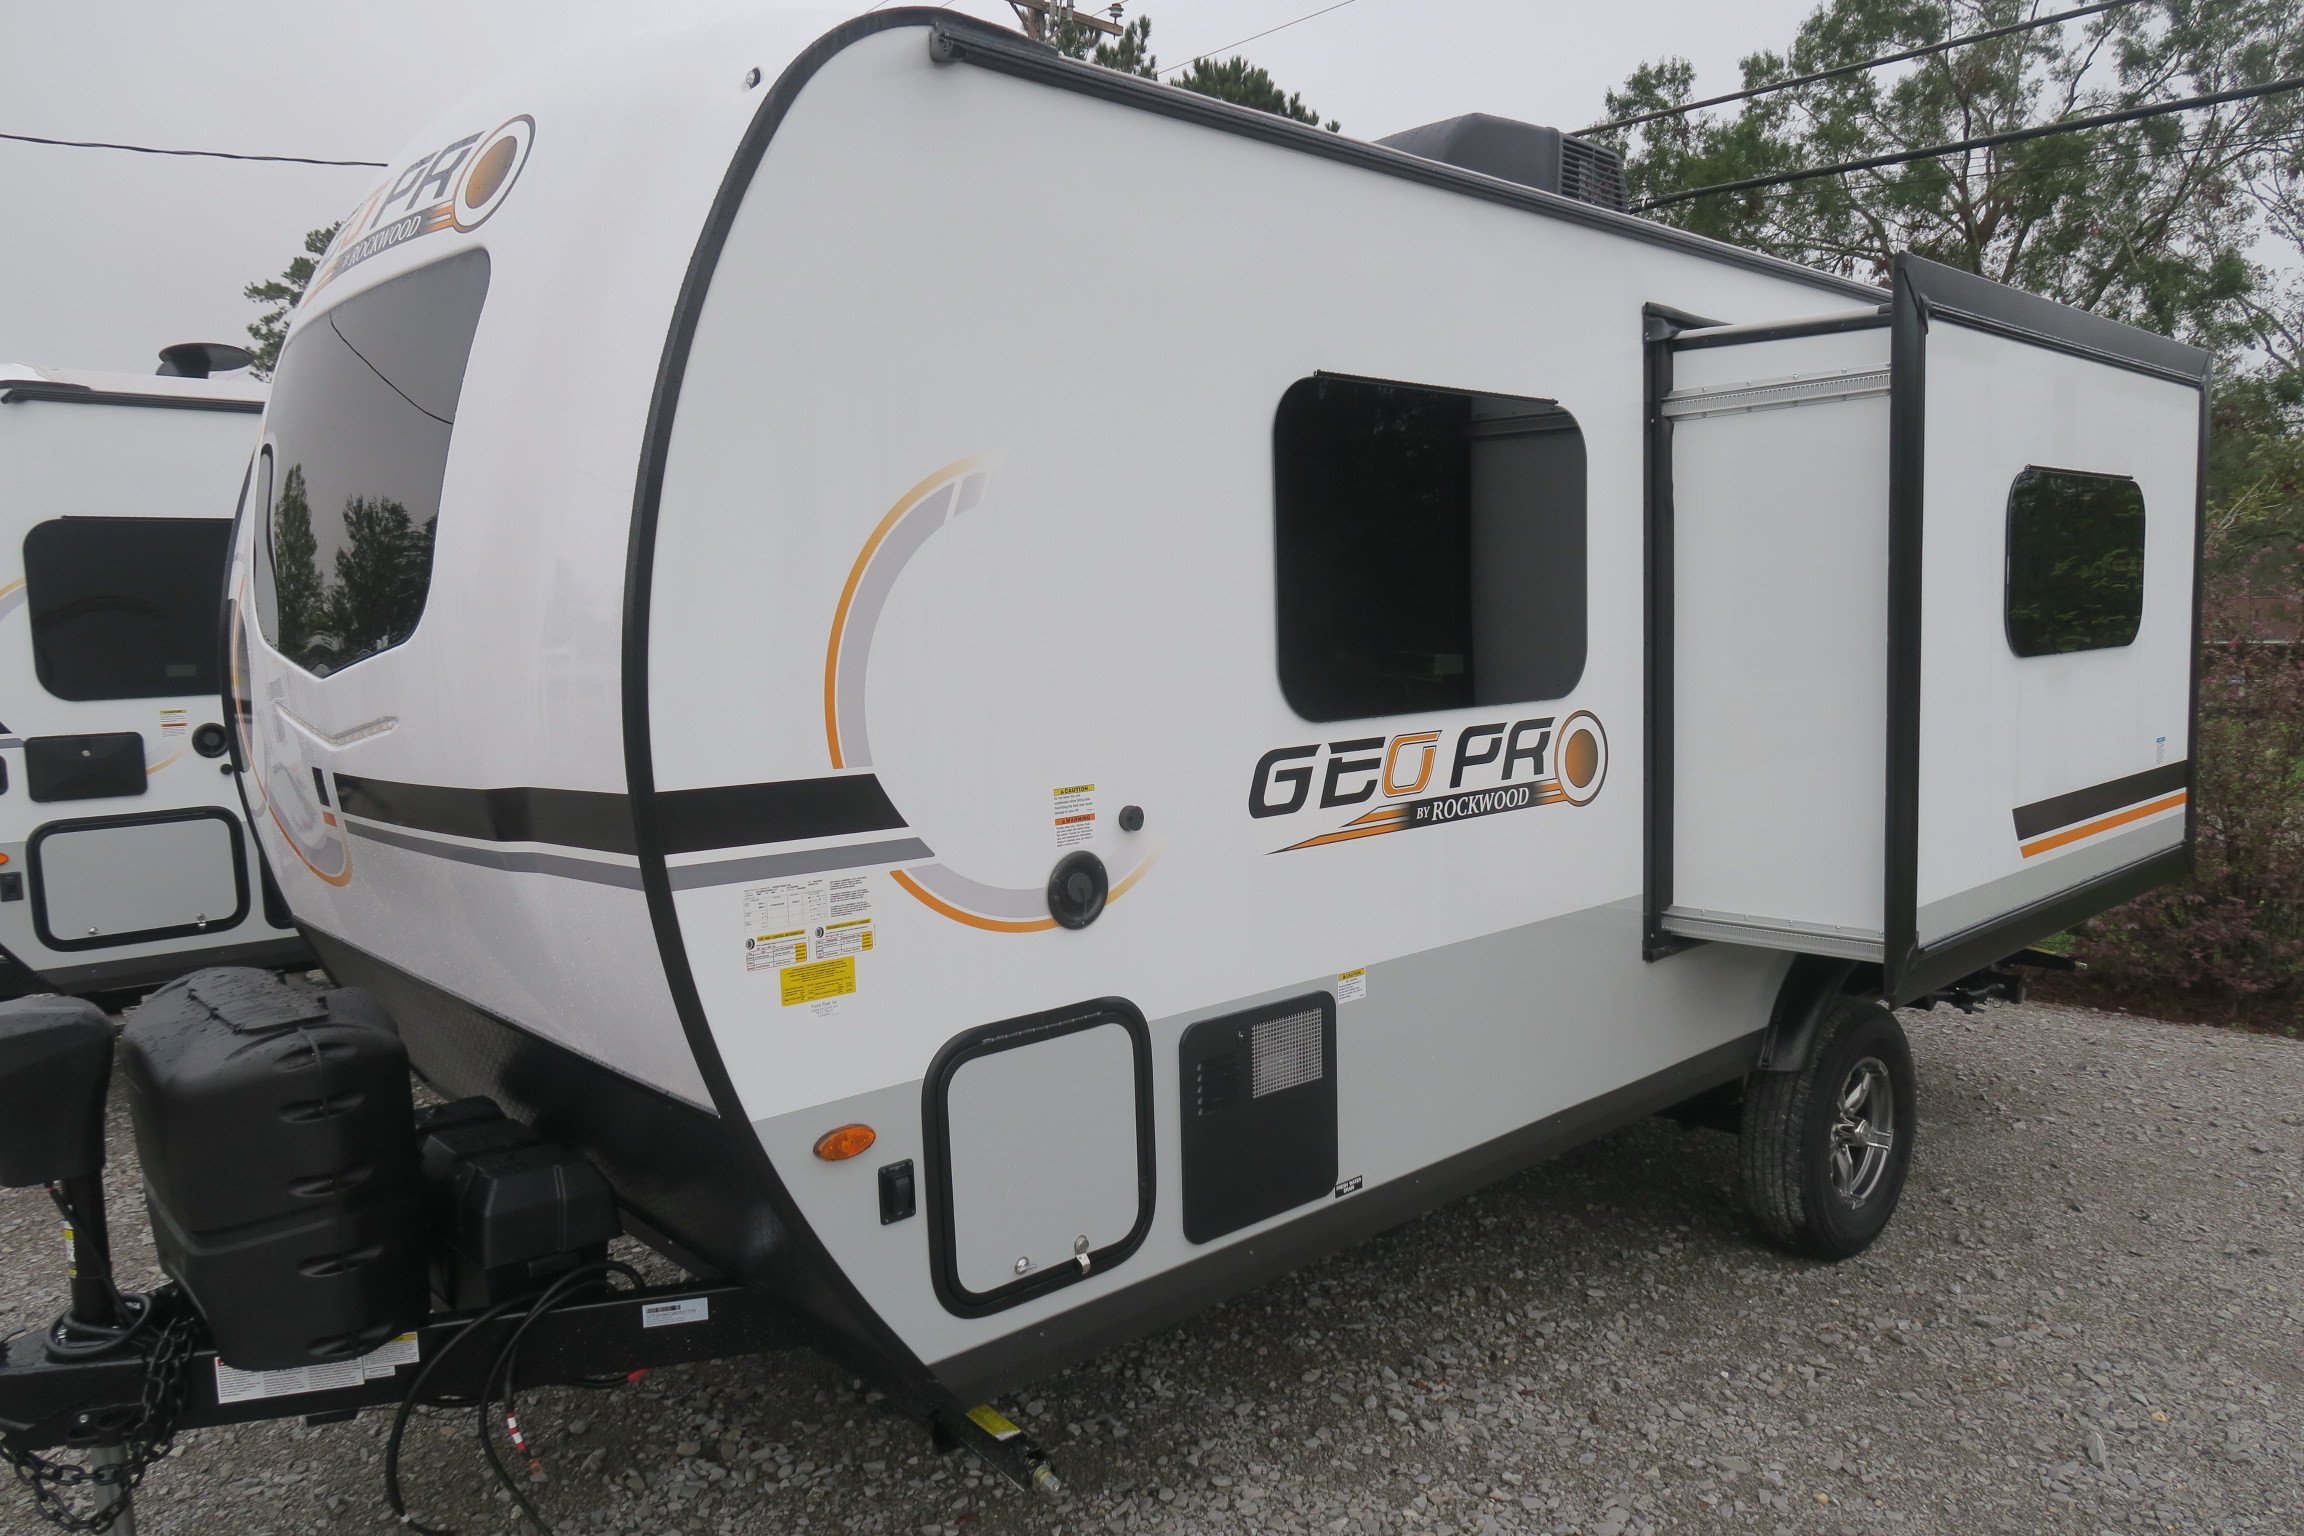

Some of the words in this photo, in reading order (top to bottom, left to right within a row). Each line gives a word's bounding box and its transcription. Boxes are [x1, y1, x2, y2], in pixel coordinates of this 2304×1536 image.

[370, 113, 536, 233] PRO
[348, 215, 422, 267] ROCKWOOD
[1248, 729, 1443, 819] GEO
[1449, 709, 1608, 807] PRO
[1064, 786, 1089, 794] CAUTION
[1416, 805, 1431, 821] BY
[1431, 787, 1530, 822] ROCKWOOD
[1066, 814, 1091, 824] WARNING
